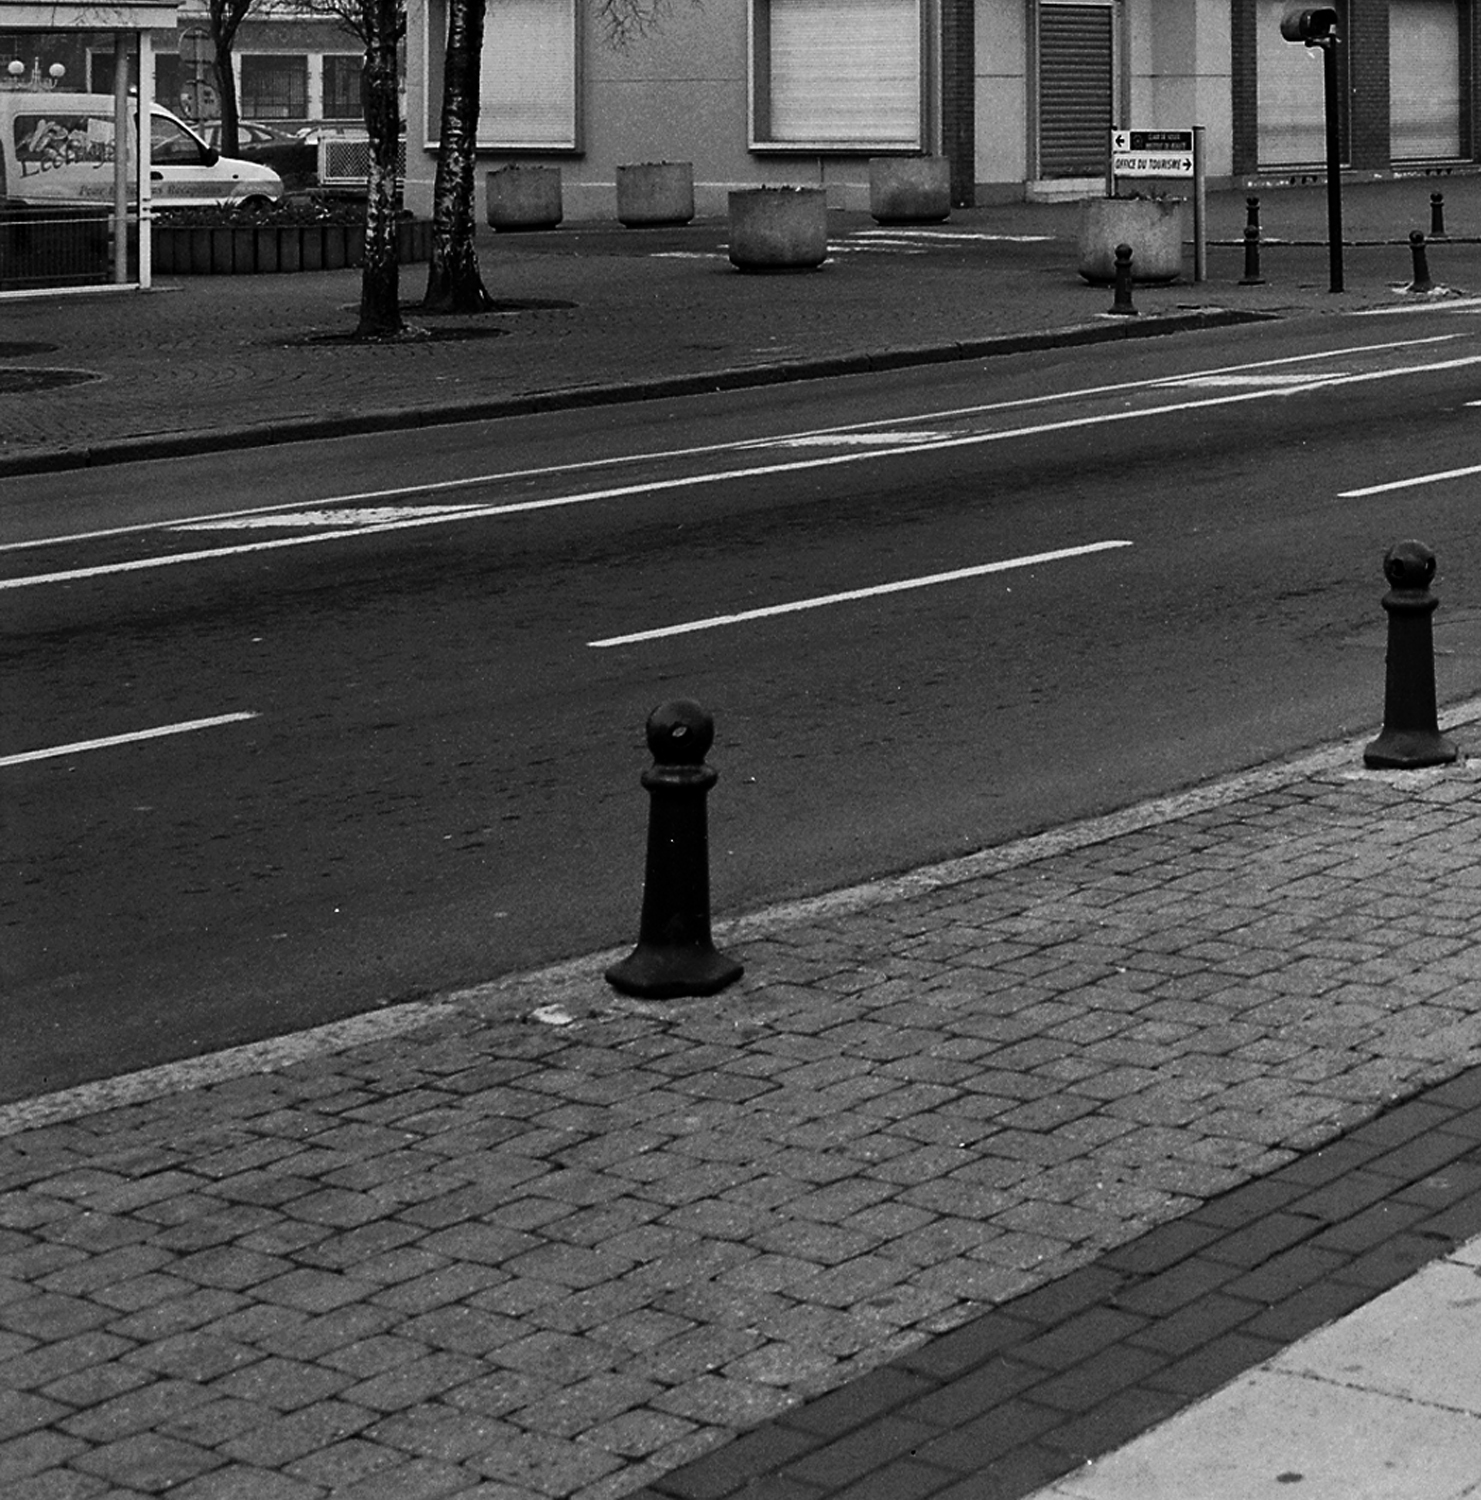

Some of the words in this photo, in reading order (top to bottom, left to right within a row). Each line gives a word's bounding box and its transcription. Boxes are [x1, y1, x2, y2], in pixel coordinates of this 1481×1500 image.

[1115, 158, 1136, 170] OFFICE
[1137, 158, 1147, 170] DU
[1149, 158, 1181, 170] TOURISME
